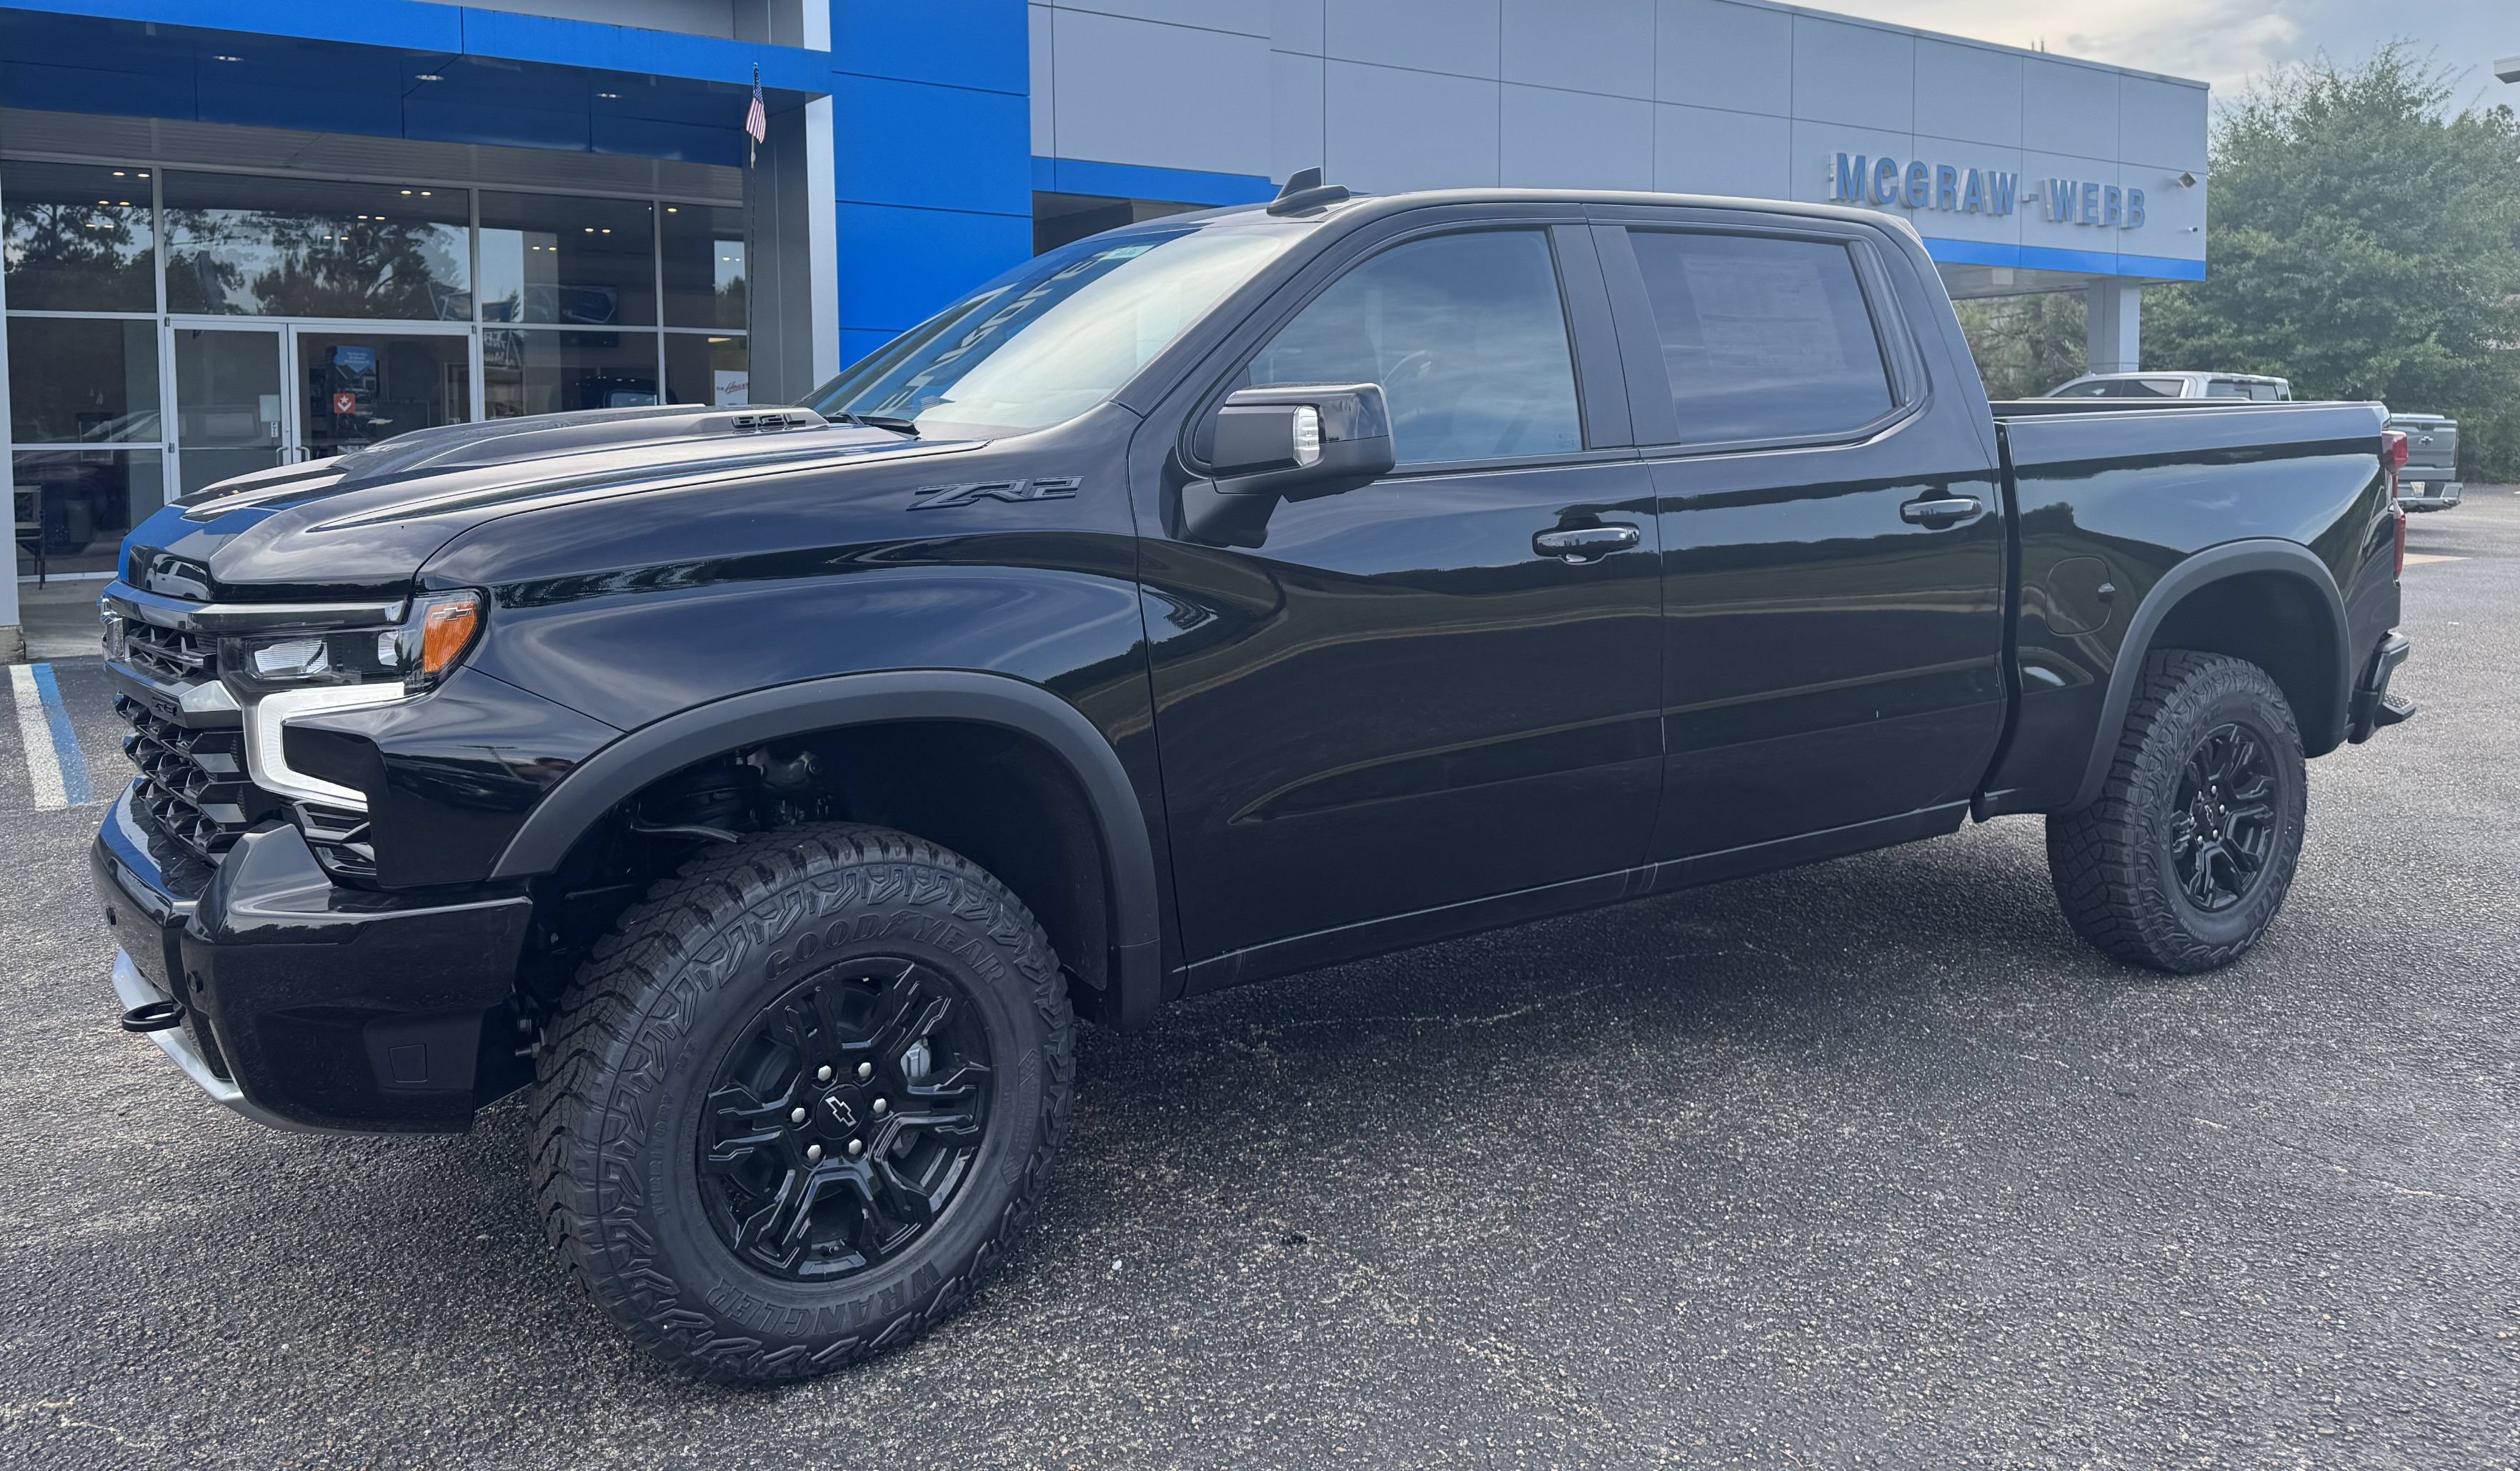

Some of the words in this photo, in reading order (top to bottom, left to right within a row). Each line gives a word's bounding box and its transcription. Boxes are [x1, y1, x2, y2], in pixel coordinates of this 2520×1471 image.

[906, 476, 1085, 512] ZR2
[765, 909, 1006, 985] GOODYEAR
[705, 1260, 942, 1337] WRANGLER
